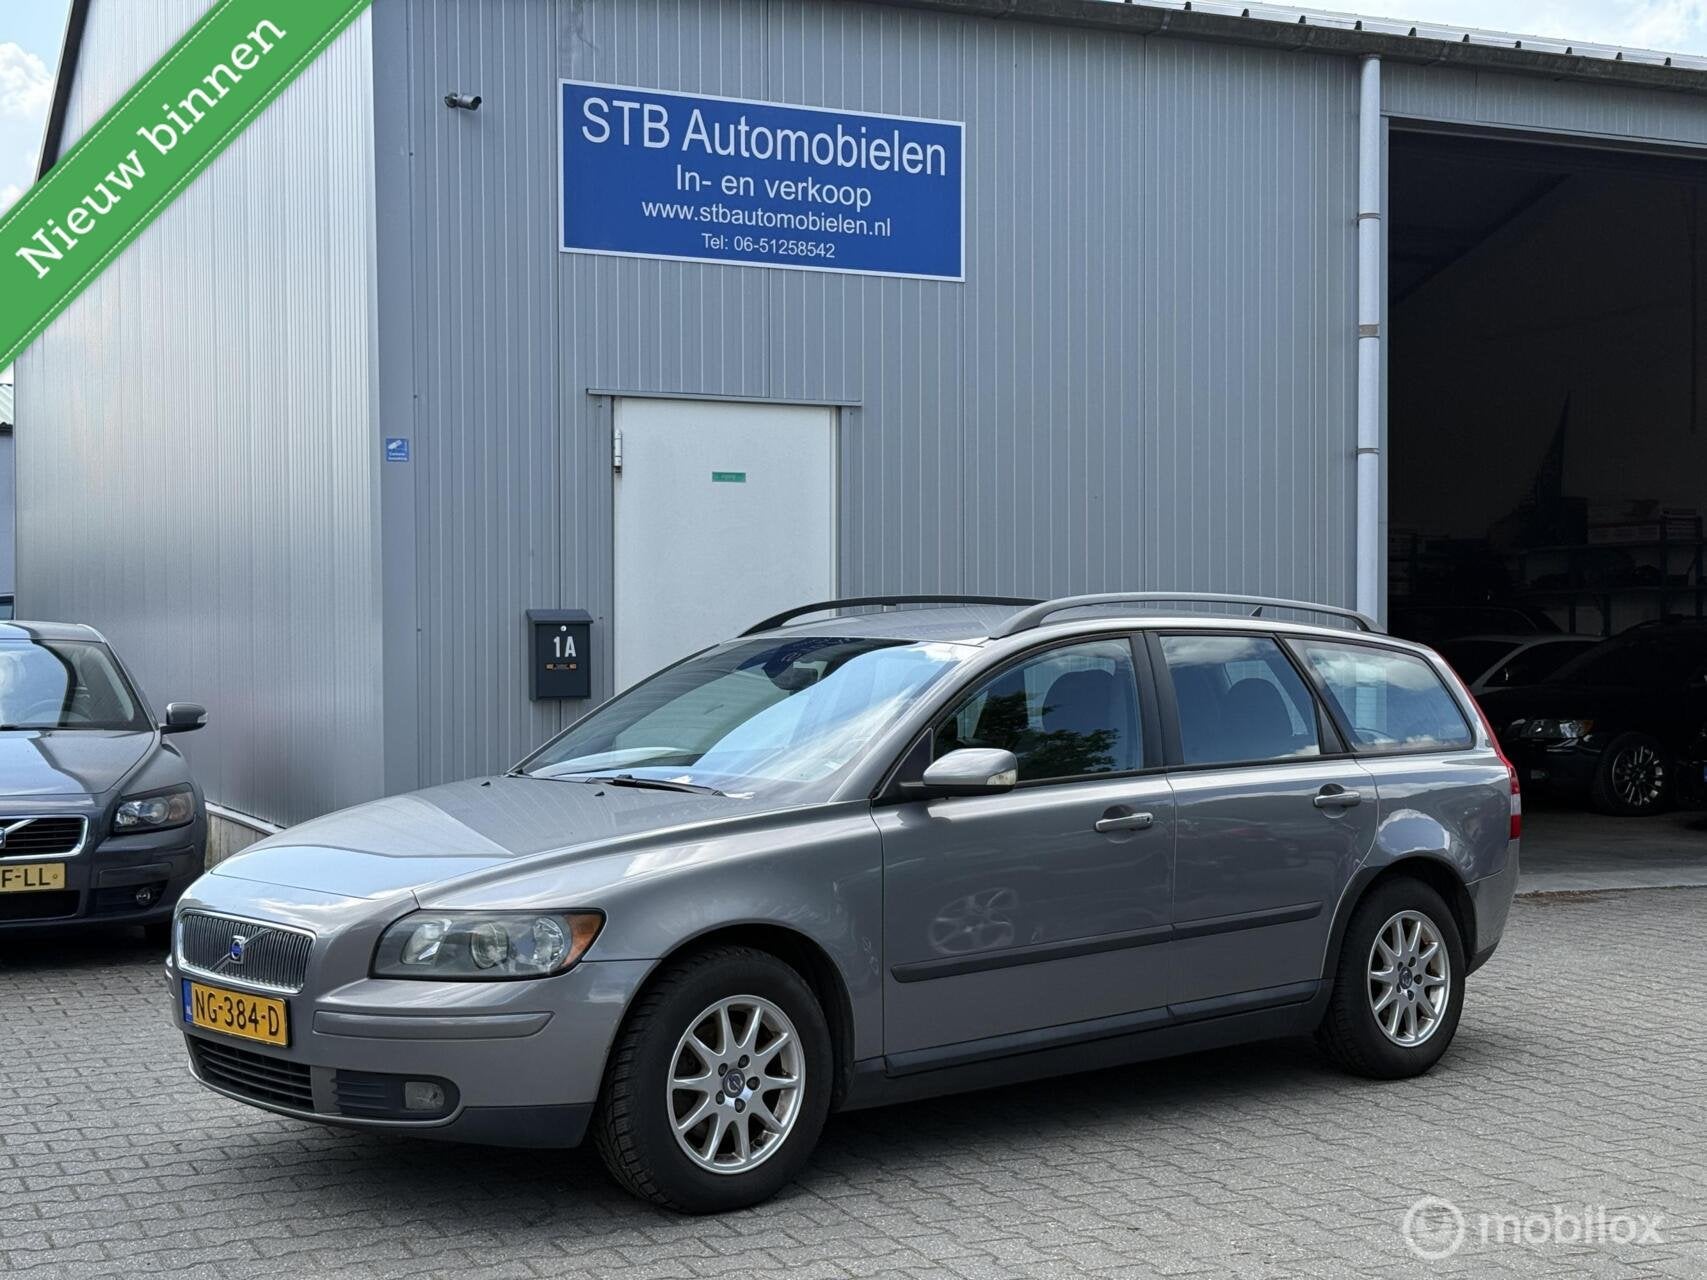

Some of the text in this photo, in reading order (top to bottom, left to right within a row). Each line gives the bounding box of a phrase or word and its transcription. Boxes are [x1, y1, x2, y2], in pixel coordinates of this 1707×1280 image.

[582, 97, 946, 176] STB Automobielen
[676, 164, 872, 212] In- en verkoop
[642, 200, 891, 237] www.stbautomobielen.nl
[702, 232, 836, 258] Tel: 06-51258542
[553, 636, 577, 658] 1A
[194, 988, 280, 1036] NG-384-D
